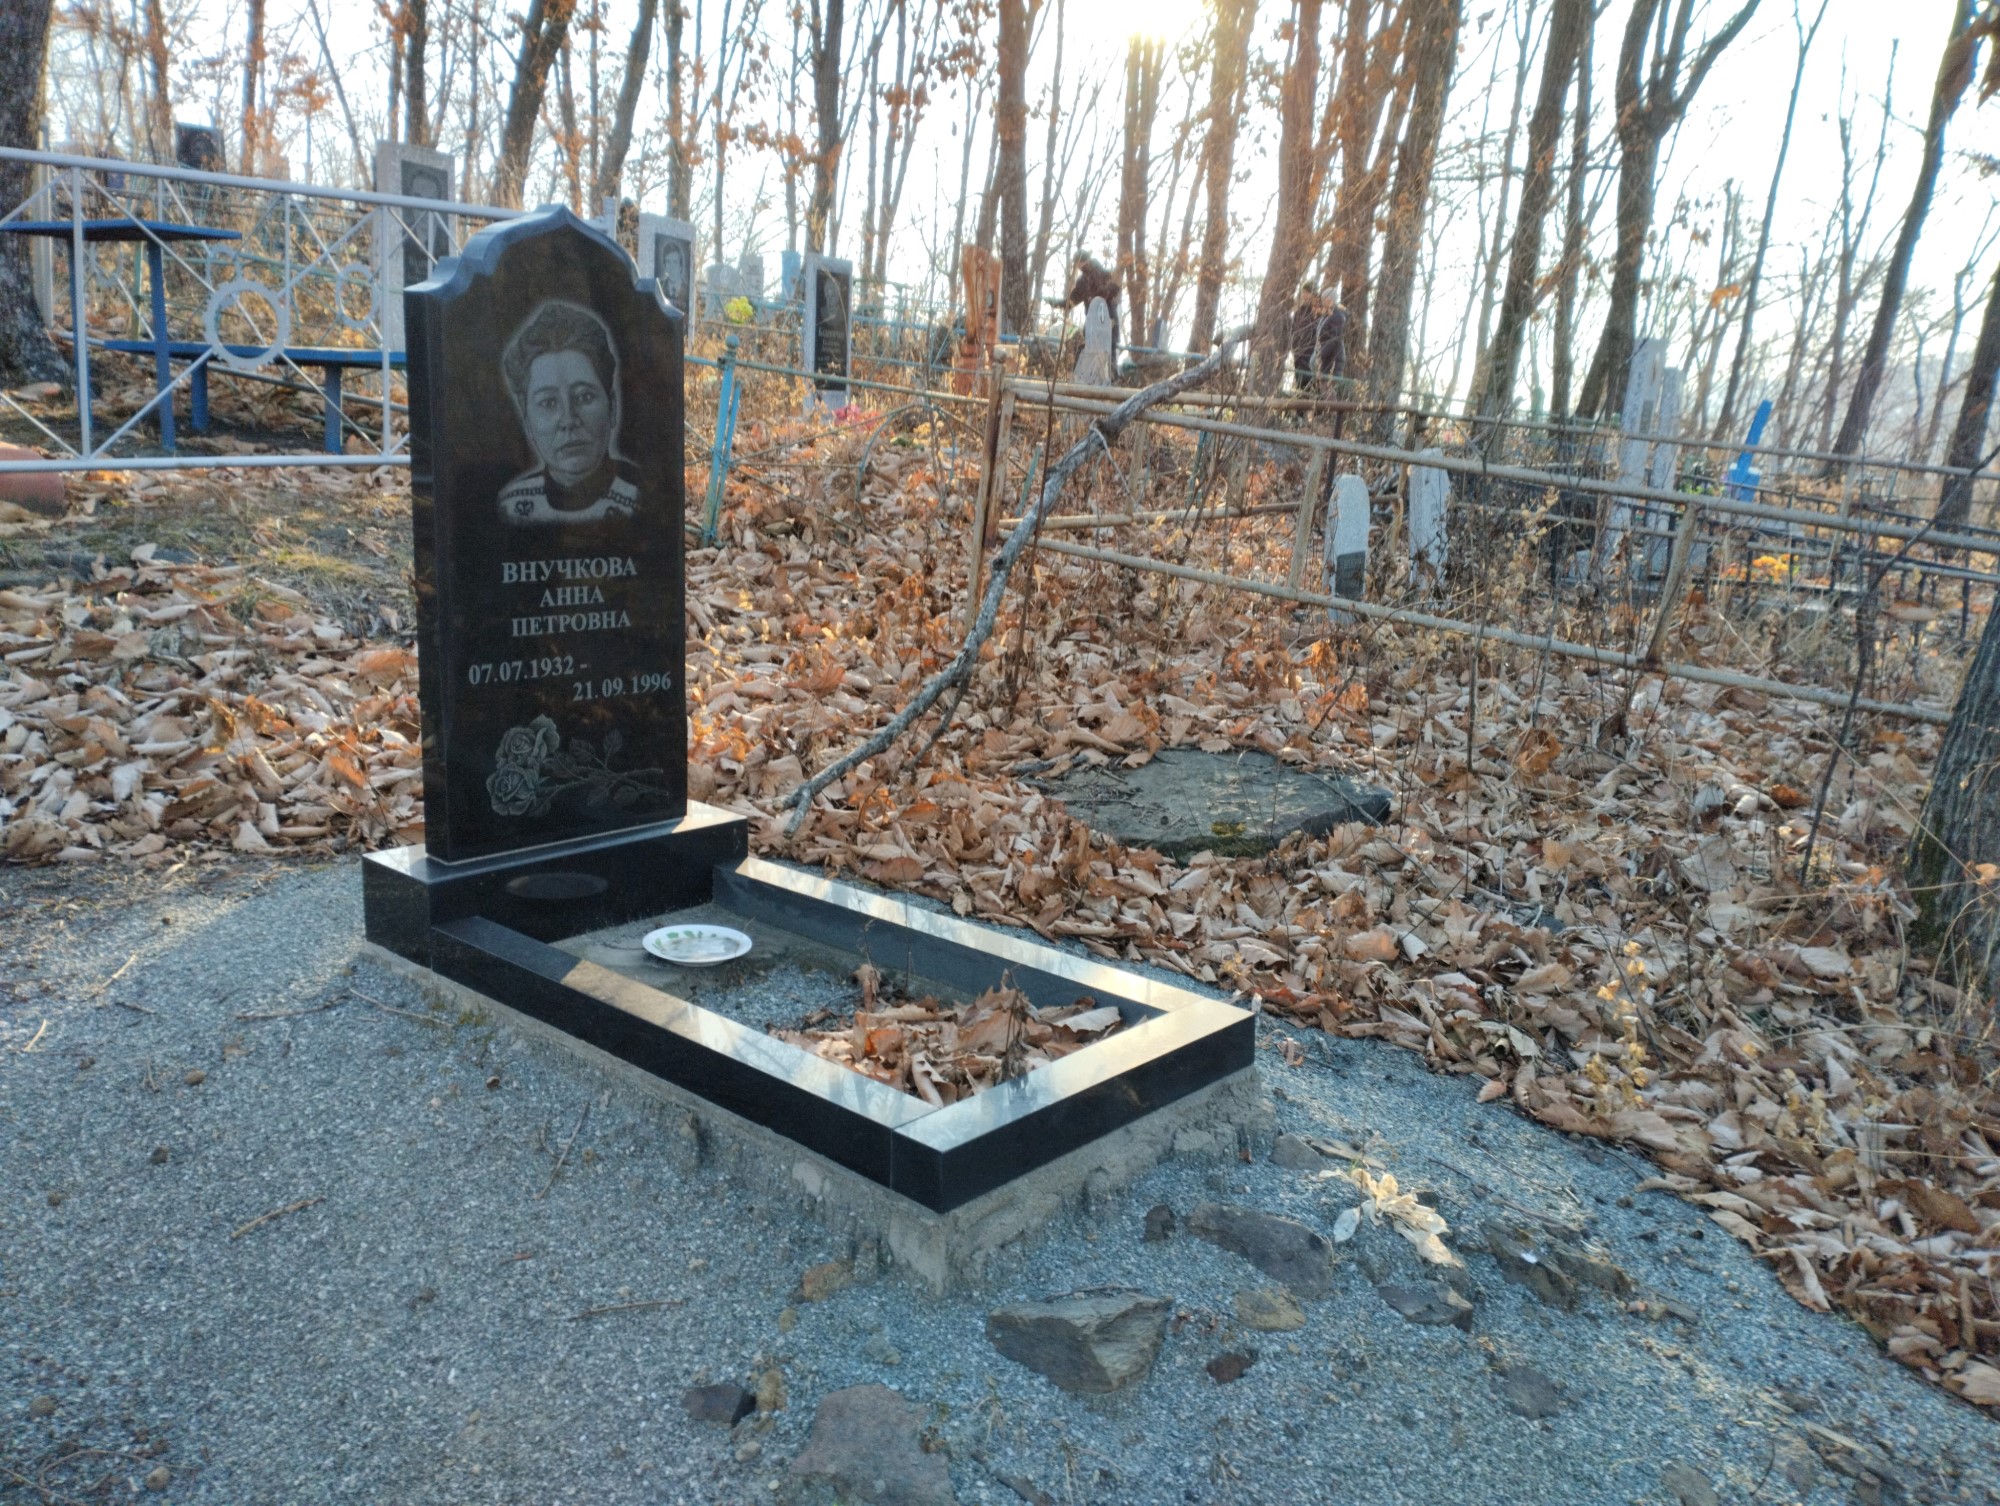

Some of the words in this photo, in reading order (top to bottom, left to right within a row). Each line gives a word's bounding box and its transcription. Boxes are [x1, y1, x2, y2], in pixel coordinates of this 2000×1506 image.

[502, 556, 637, 583] ВНУЧКОВА
[540, 585, 604, 608] АННА
[512, 610, 631, 637] ПЕТРОВНА
[572, 672, 672, 701] 21.09.1996
